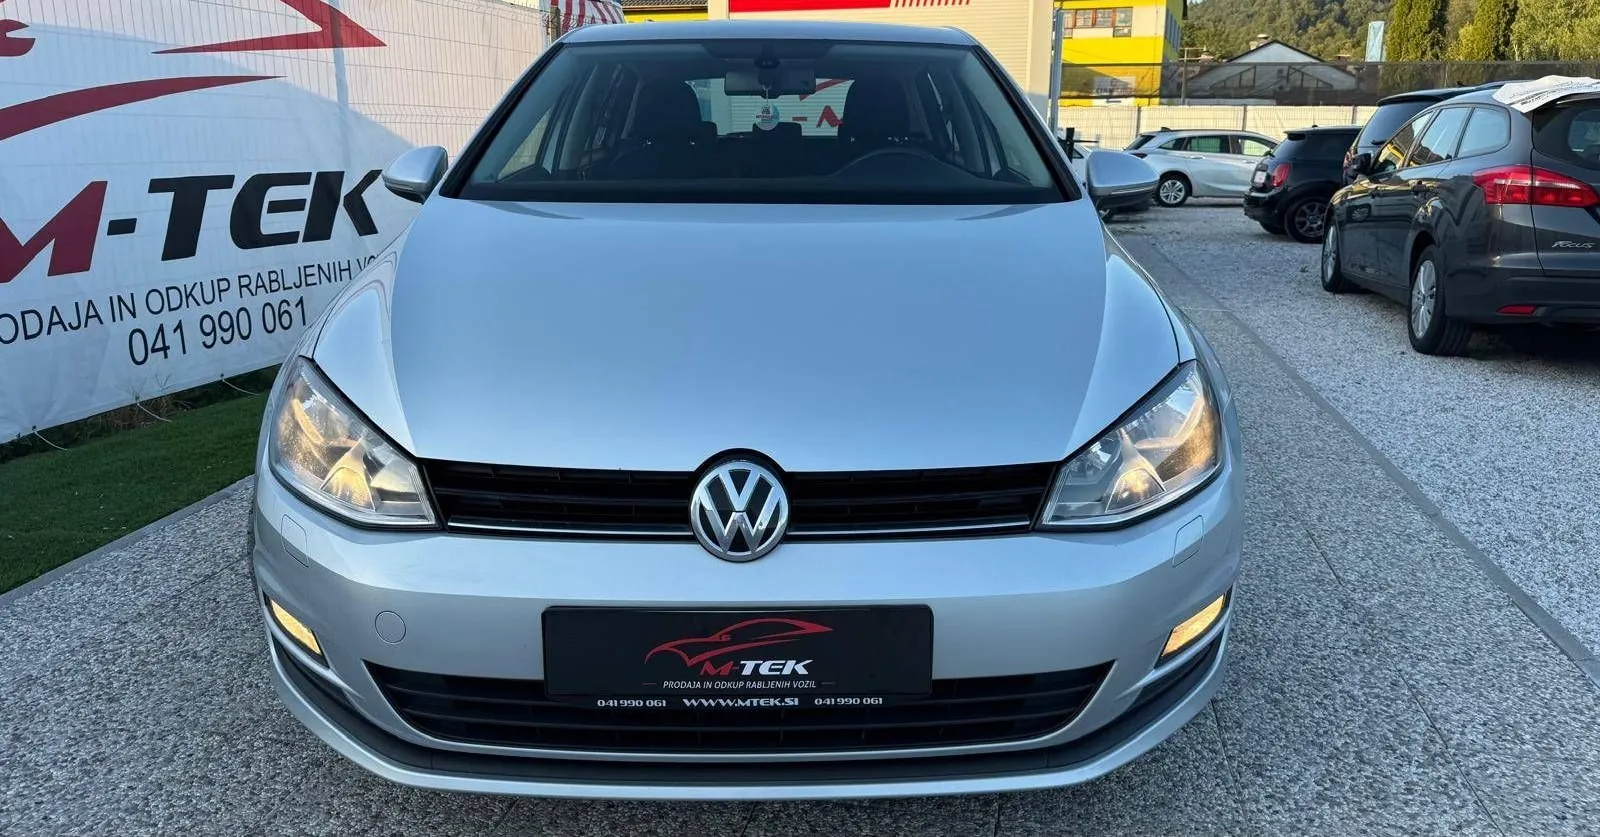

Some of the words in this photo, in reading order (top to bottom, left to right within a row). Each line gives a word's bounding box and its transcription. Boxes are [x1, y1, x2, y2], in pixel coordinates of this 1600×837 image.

[108, 292, 137, 322] IN
[145, 277, 231, 315] ODKUP
[237, 259, 353, 299] RABLJENIH
[128, 319, 187, 366] 041
[199, 306, 252, 350] 990
[262, 295, 306, 334] 061
[700, 659, 814, 676] M-TEK
[662, 680, 701, 689] PRODAJA
[703, 681, 713, 689] IN
[714, 680, 745, 689] ODKUP
[745, 680, 791, 689] RABLJENIH
[792, 680, 817, 689] VOZIL
[597, 699, 618, 707] 041
[619, 699, 643, 707] 990
[645, 699, 667, 707] 061
[682, 697, 799, 707] WWW.MTEK.SI
[814, 697, 835, 706] 041
[836, 697, 860, 706] 990
[862, 697, 883, 706] 061
